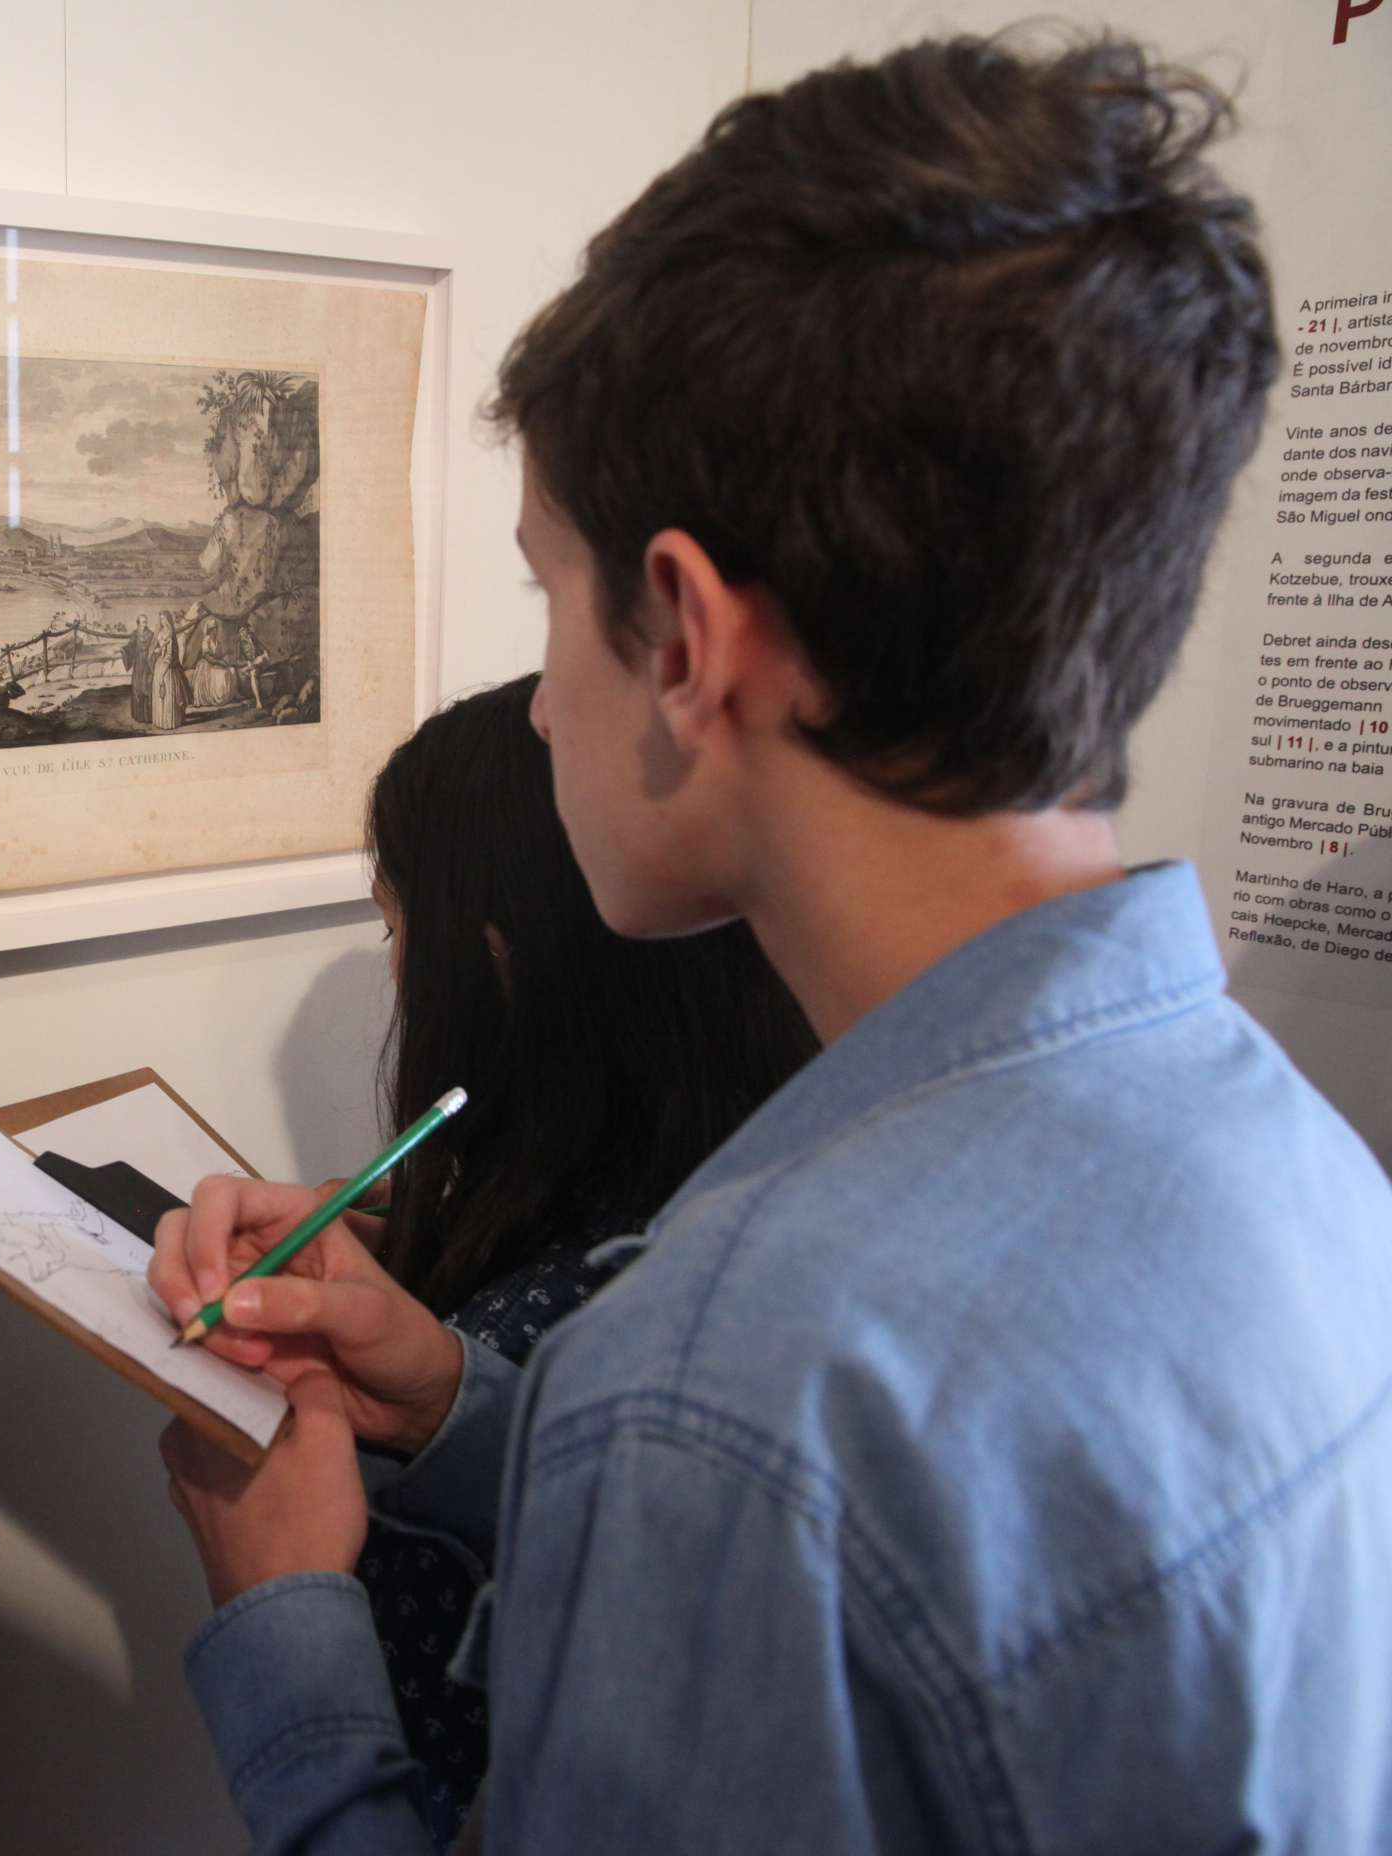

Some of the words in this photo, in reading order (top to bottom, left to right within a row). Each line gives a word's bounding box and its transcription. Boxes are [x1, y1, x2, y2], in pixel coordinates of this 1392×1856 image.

[1299, 299, 1311, 312] A
[1314, 294, 1377, 315] primeira
[1308, 319, 1326, 333] 21
[1295, 342, 1314, 356] de
[1293, 361, 1304, 377] É
[1309, 358, 1373, 379] possível
[1290, 384, 1334, 398] Santa
[1339, 380, 1392, 394] Bárbar
[1286, 427, 1323, 440] Vinte
[1329, 426, 1367, 438] anos
[1374, 422, 1392, 435] de
[1283, 448, 1325, 461] dante
[1329, 446, 1356, 459] dos
[1361, 444, 1392, 457] navi
[1281, 469, 1318, 482] onde
[1324, 468, 1392, 480] observa-
[1279, 490, 1337, 505] imagem
[1341, 488, 1360, 501] da
[1276, 511, 1306, 523] São
[1310, 509, 1360, 526] Miguel
[1271, 552, 1282, 564] A
[1304, 552, 1371, 568] segunda
[1384, 554, 1392, 564] e
[1270, 573, 1342, 587] Kotzebue,
[1267, 593, 1309, 606] frente
[1313, 594, 1322, 606] à
[1327, 594, 1354, 607] Ilha
[1359, 594, 1378, 607] de
[1381, 594, 1392, 607] A
[1263, 633, 1311, 647] Debret
[1315, 635, 1357, 649] ainda
[1362, 637, 1392, 650] des
[1260, 654, 1281, 666] tes
[1286, 658, 1309, 667] em
[1315, 655, 1358, 669] frente
[1363, 660, 1383, 670] ao
[1258, 677, 1267, 686] o
[1271, 676, 1312, 689] ponto
[1316, 677, 1335, 689] de
[1340, 678, 1392, 692] observ
[1256, 694, 1273, 706] de
[1278, 695, 1382, 713] Brueggemann
[1254, 715, 1351, 731] movimentado
[1370, 721, 1389, 734] 10
[1251, 735, 1272, 746] sul
[1287, 736, 1302, 749] 11
[1324, 741, 1333, 751] e
[1338, 742, 1347, 752] a
[2, 765, 31, 777] VUE
[37, 762, 54, 773] DE
[1249, 755, 1324, 770] submarino
[1328, 762, 1347, 772] na
[1351, 761, 1384, 775] baia
[1245, 792, 1264, 805] Na
[1272, 798, 1328, 812] gravura
[1336, 801, 1355, 814] de
[1363, 803, 1392, 820] Bru
[1242, 814, 1285, 829] antigo
[1289, 816, 1353, 834] Mercado
[1240, 831, 1313, 850] Novembro
[1329, 841, 1339, 853] 8
[1236, 870, 1299, 889] Martinho
[1302, 878, 1322, 893] de
[1326, 881, 1367, 899] Haro,
[1373, 890, 1383, 899] a
[1233, 890, 1250, 902] rio
[1255, 895, 1285, 907] com
[1288, 895, 1329, 913] obras
[1335, 905, 1376, 919] como
[1381, 911, 1391, 921] o
[1230, 910, 1258, 923] cais
[1262, 912, 1330, 935] Hoepcke,
[1337, 923, 1392, 942] Mercad
[1228, 926, 1297, 950] Reflexão,
[1301, 939, 1319, 951] de
[1325, 941, 1369, 960] Diego
[1374, 949, 1392, 962] de
